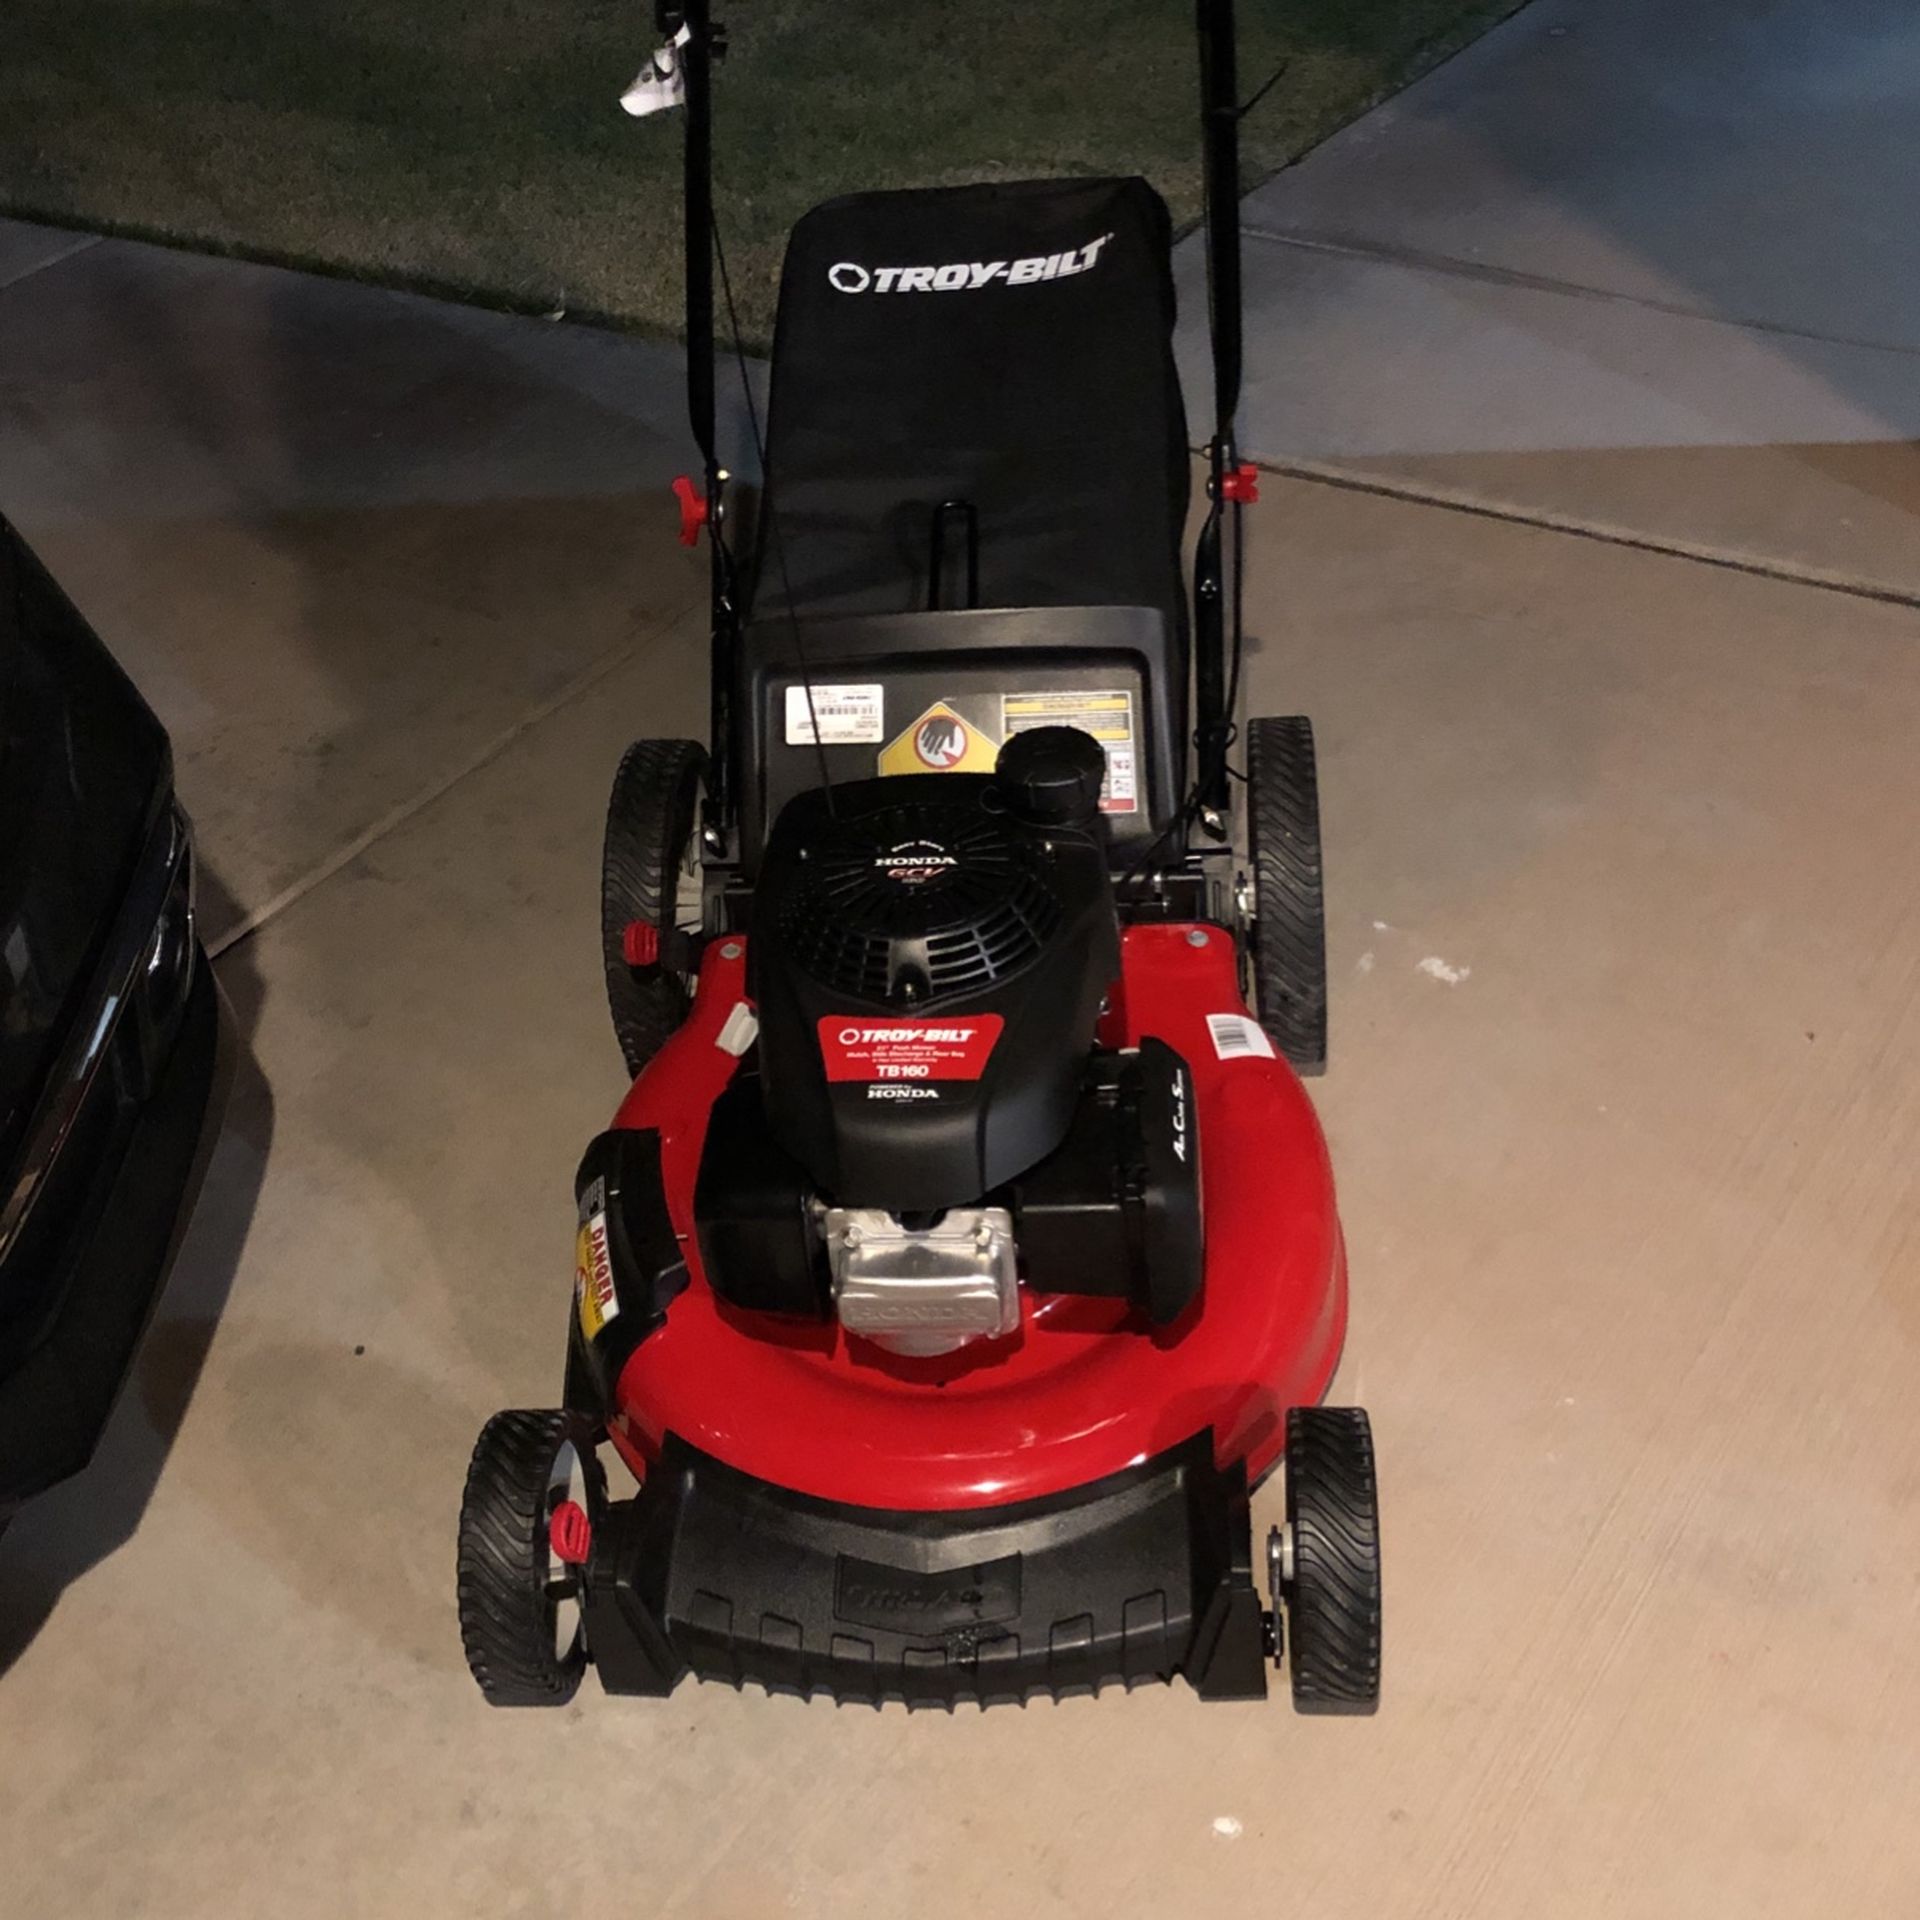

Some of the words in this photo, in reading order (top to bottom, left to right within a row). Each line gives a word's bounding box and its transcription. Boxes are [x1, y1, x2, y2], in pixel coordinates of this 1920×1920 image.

[873, 235, 1108, 293] TROY-BILT
[874, 856, 959, 867] HONDA
[861, 1028, 974, 1043] TROY-BILT
[876, 1065, 930, 1077] TB160
[867, 1089, 940, 1099] HONDA
[591, 1226, 614, 1309] DANGER
